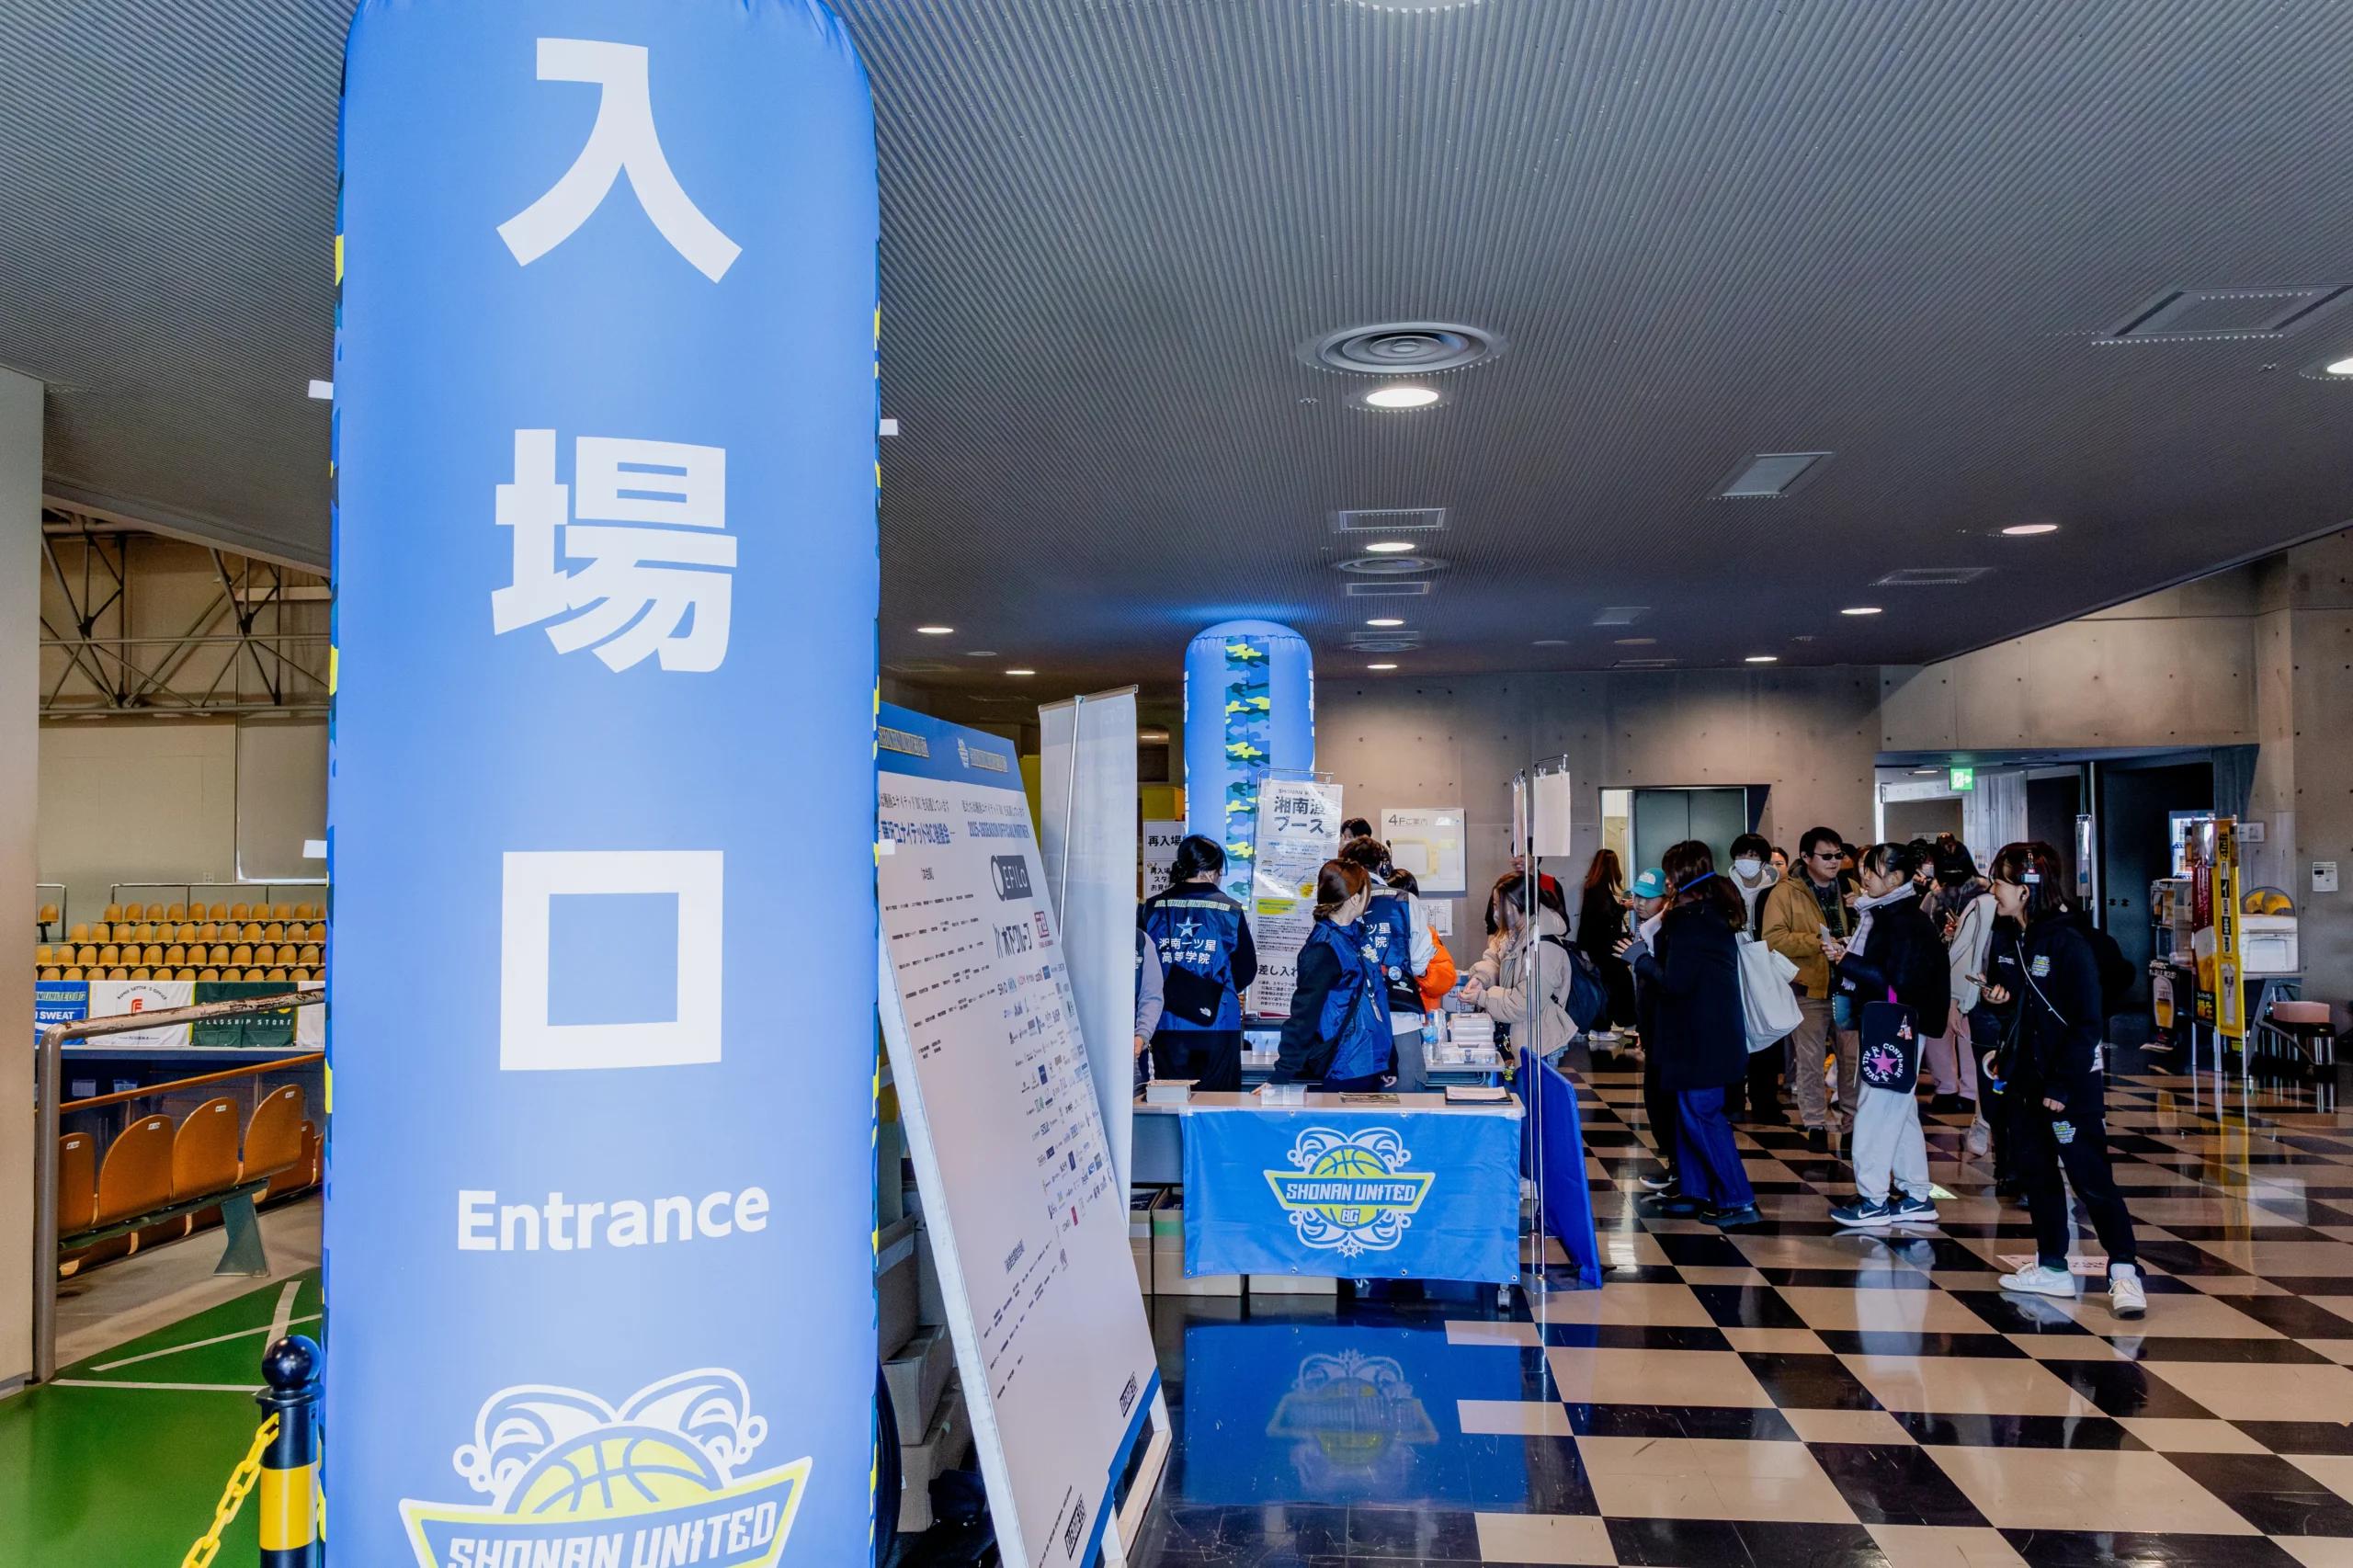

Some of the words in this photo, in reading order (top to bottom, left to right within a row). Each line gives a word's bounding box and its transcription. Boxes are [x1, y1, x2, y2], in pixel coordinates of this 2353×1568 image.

[492, 38, 743, 1072] 入場口
[1274, 816, 1324, 834] ブース
[1148, 835, 1186, 846] 再入場
[40, 1011, 74, 1020] SWEAT
[1286, 1183, 1352, 1200] SHONAN
[1355, 1184, 1416, 1202] UNITED
[458, 1187, 770, 1251] Entrance
[1341, 1209, 1359, 1223] BC
[448, 1533, 624, 1568] SHONAN
[634, 1501, 778, 1568] UNITED
